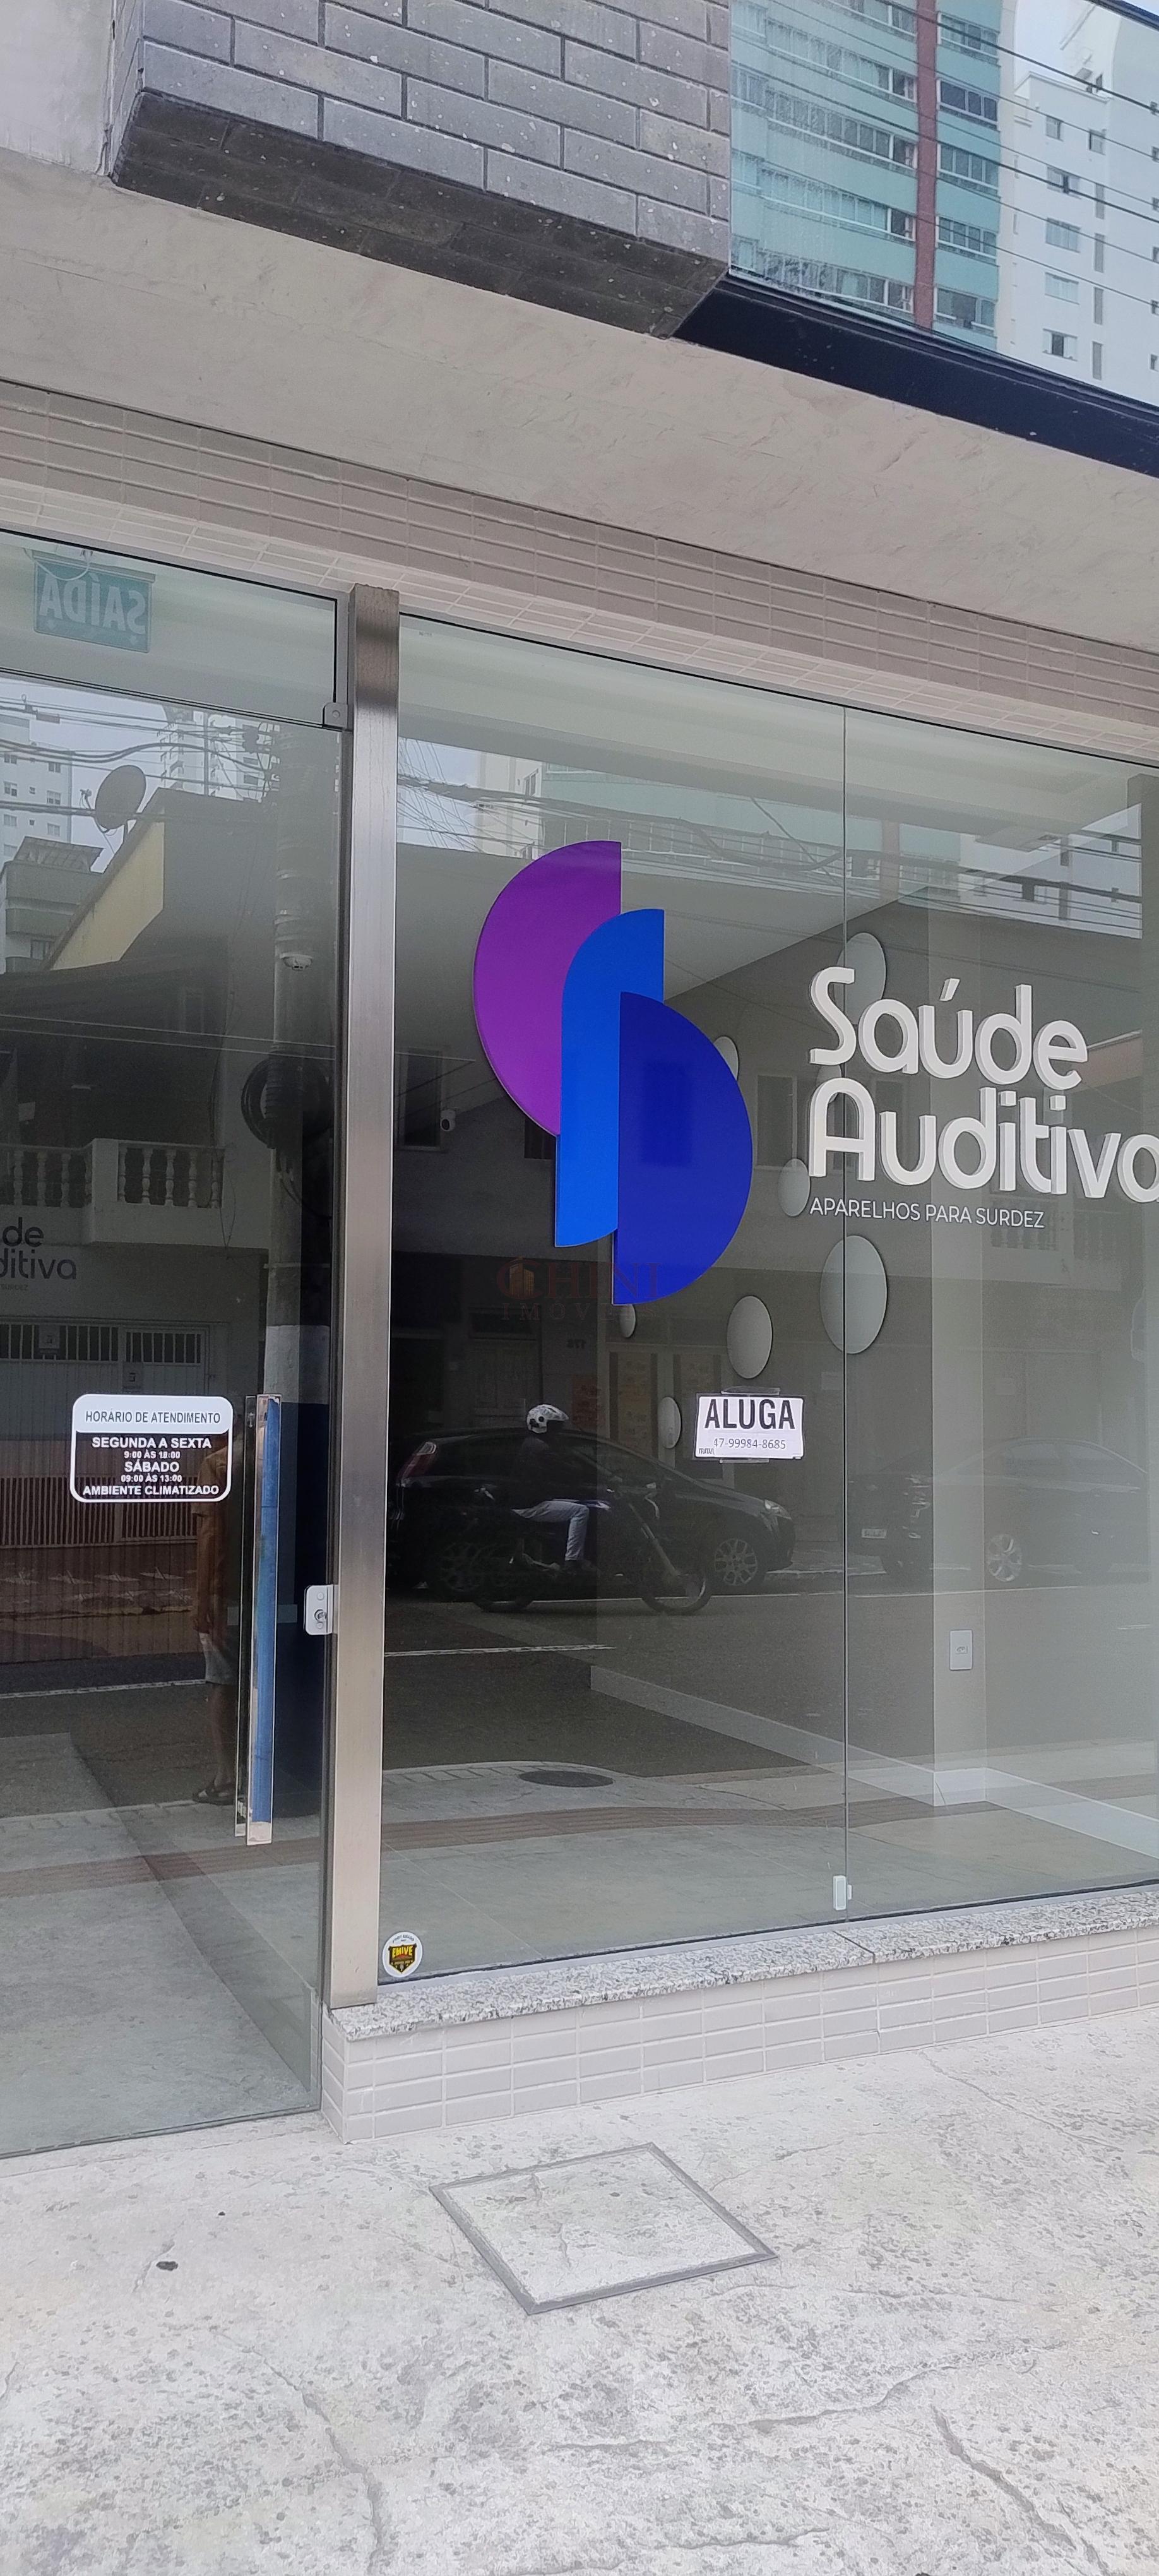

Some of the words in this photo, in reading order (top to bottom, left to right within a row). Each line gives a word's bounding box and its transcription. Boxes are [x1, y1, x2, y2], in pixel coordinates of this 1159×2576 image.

[809, 966, 1088, 1090] Saúde
[809, 1197, 920, 1221] APARELHOS
[925, 1203, 973, 1224] PARA
[975, 1207, 1045, 1229] SURDEZ
[86, 1409, 133, 1422] HORÁRIO
[135, 1411, 148, 1423] DE
[151, 1412, 220, 1423] ATENDIMENTO
[704, 1398, 795, 1429] ALUGA
[92, 1437, 156, 1448] SEGUNDA
[158, 1437, 168, 1448] A
[170, 1438, 211, 1448] SEXTA
[714, 1438, 786, 1450] 47-99984-8685
[143, 1449, 157, 1458] ÀS
[158, 1451, 181, 1459] 18:00
[124, 1459, 179, 1472] SÁBADO
[145, 1473, 158, 1482] ÀS
[83, 1486, 142, 1495] AMBIENTE
[145, 1485, 219, 1495] CLIMATIZADO
